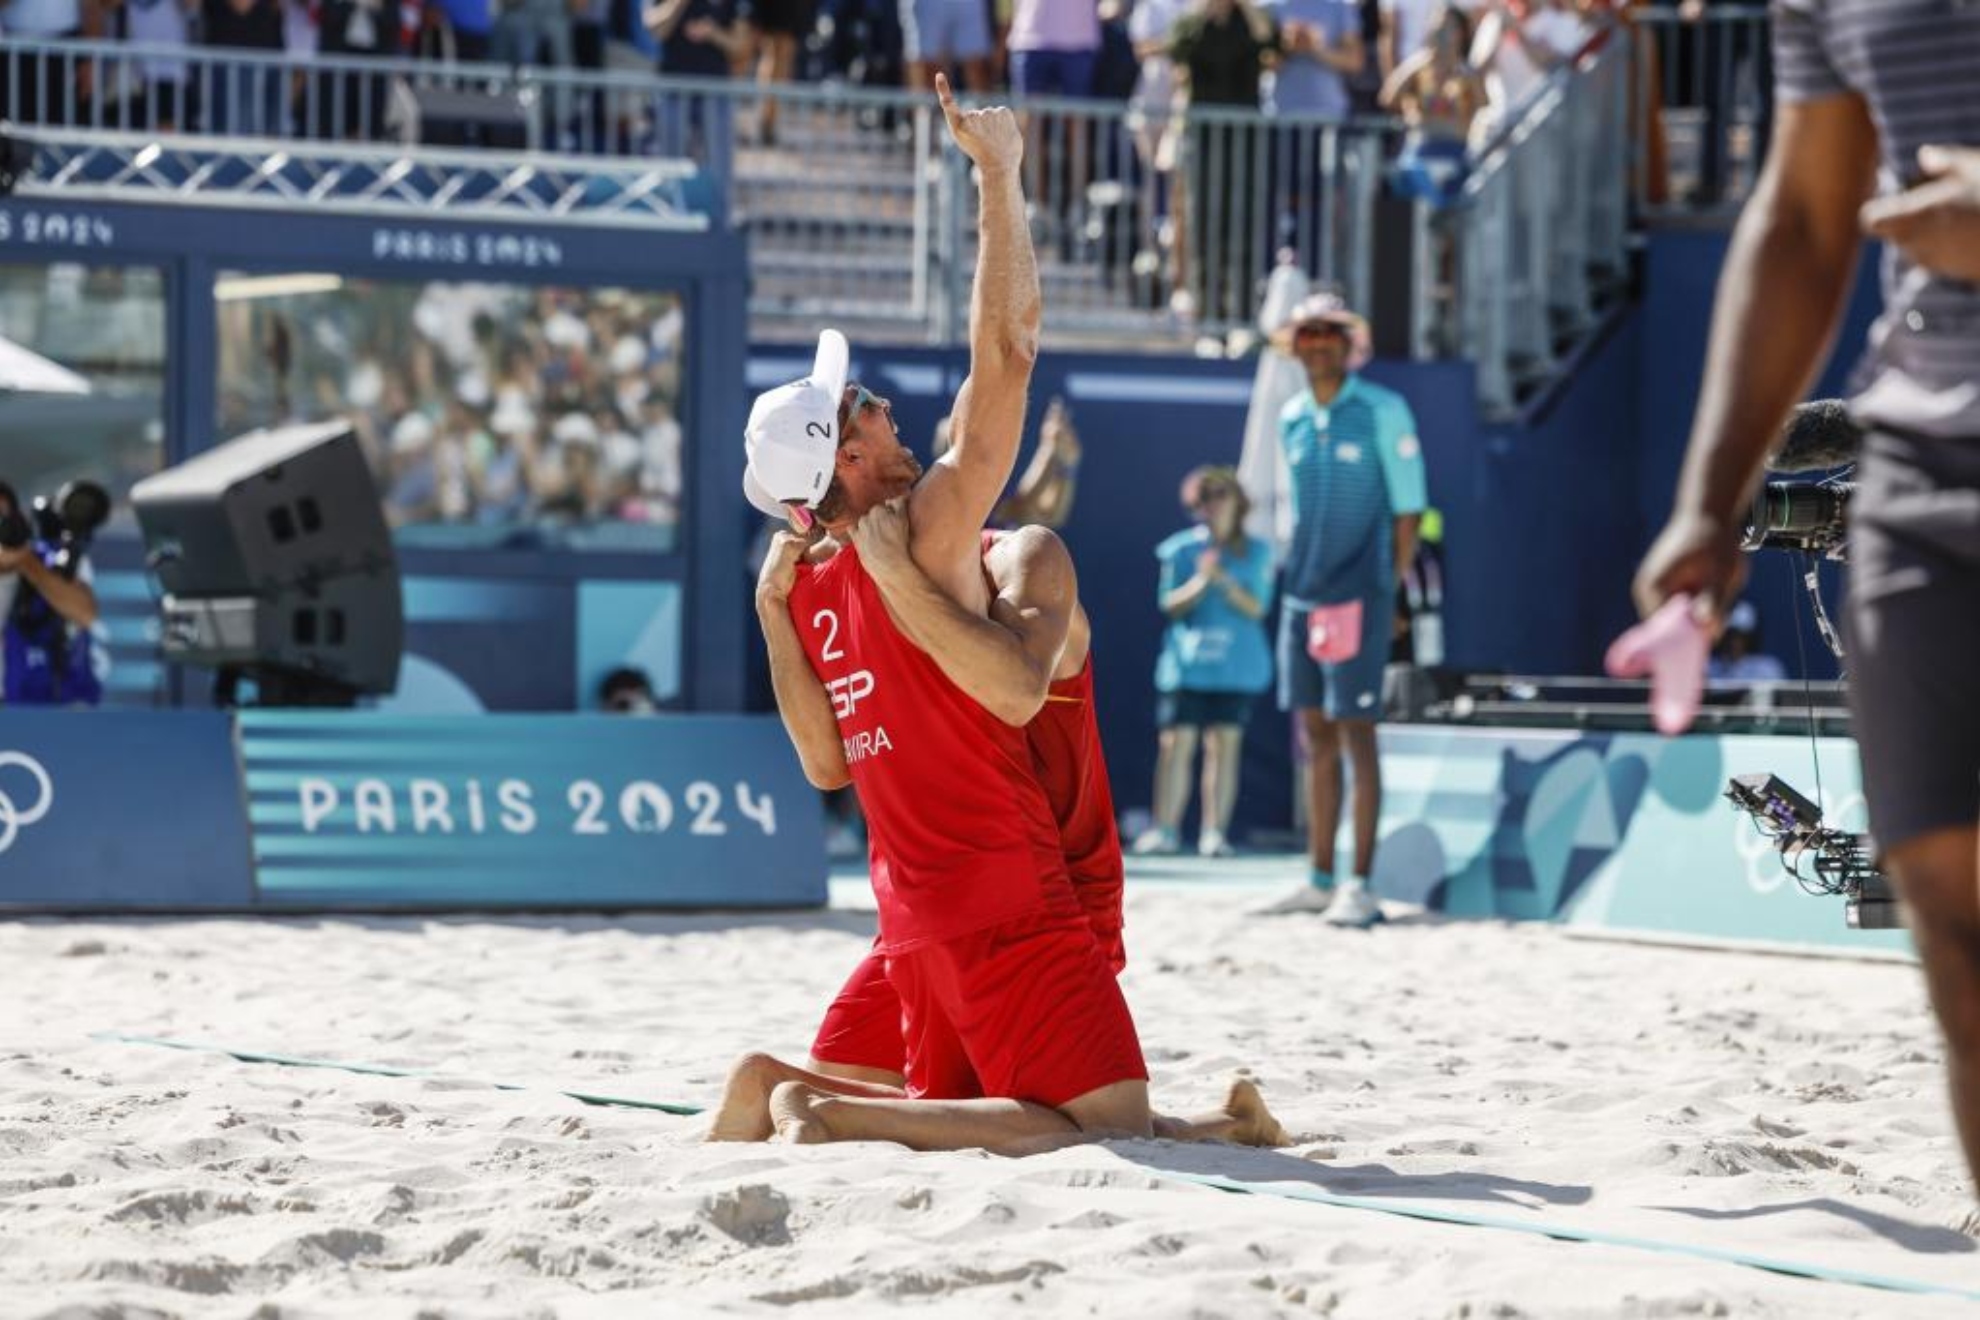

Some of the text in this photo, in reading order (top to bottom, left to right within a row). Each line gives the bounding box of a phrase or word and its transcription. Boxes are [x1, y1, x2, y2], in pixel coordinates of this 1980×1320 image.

[805, 421, 831, 439] 2
[813, 609, 845, 663] 2
[825, 669, 875, 720] SP
[566, 780, 776, 835] 2024
